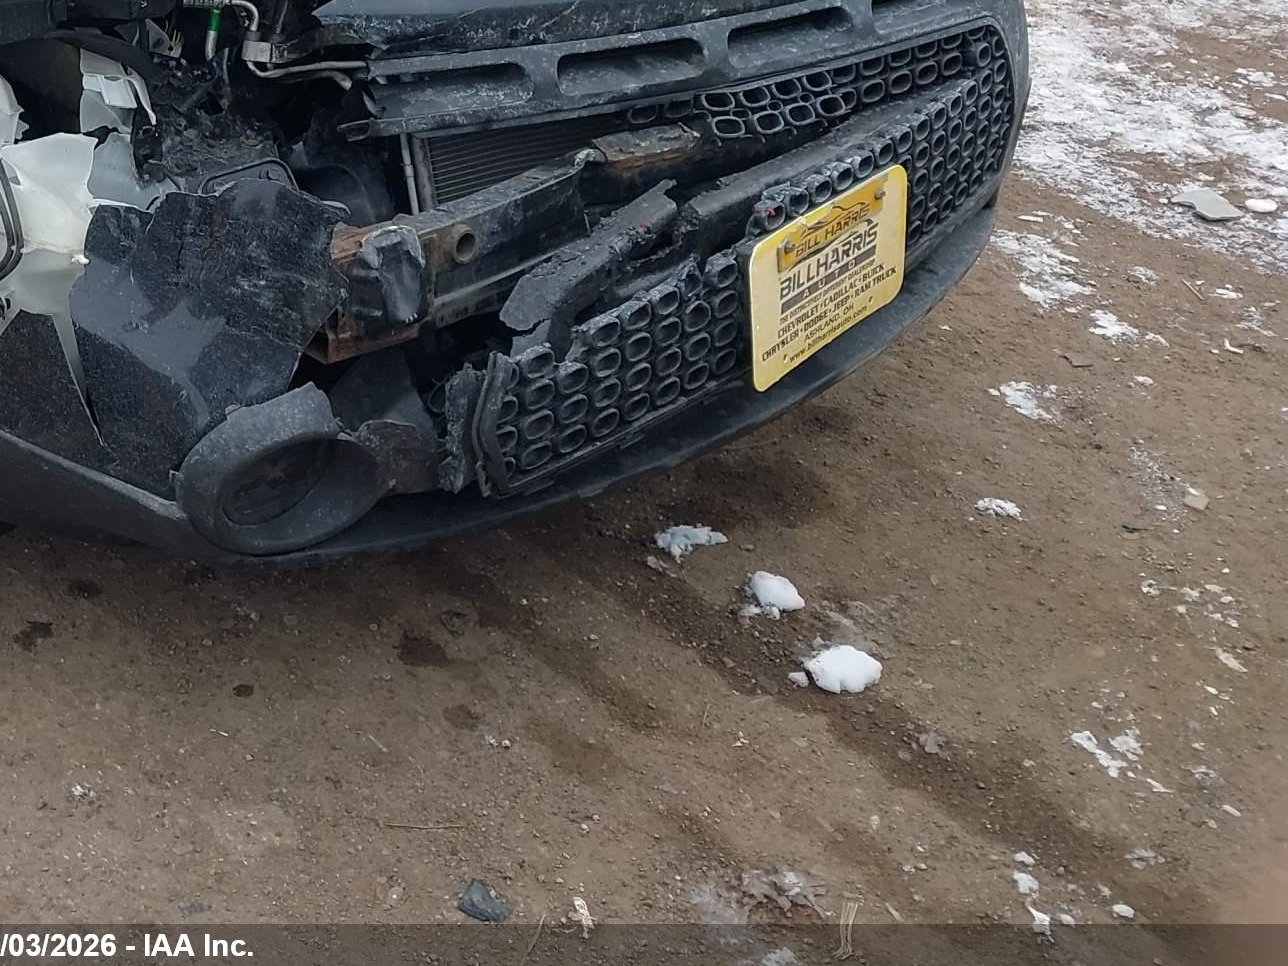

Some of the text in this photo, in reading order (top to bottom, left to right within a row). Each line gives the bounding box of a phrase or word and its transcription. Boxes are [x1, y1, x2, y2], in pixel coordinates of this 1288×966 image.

[795, 233, 820, 258] BILL
[761, 265, 896, 362] CHRYSLER DODGE JEEP RAM TRUCK
[777, 262, 884, 339] CHEVROLET CADILLAC BUICK
